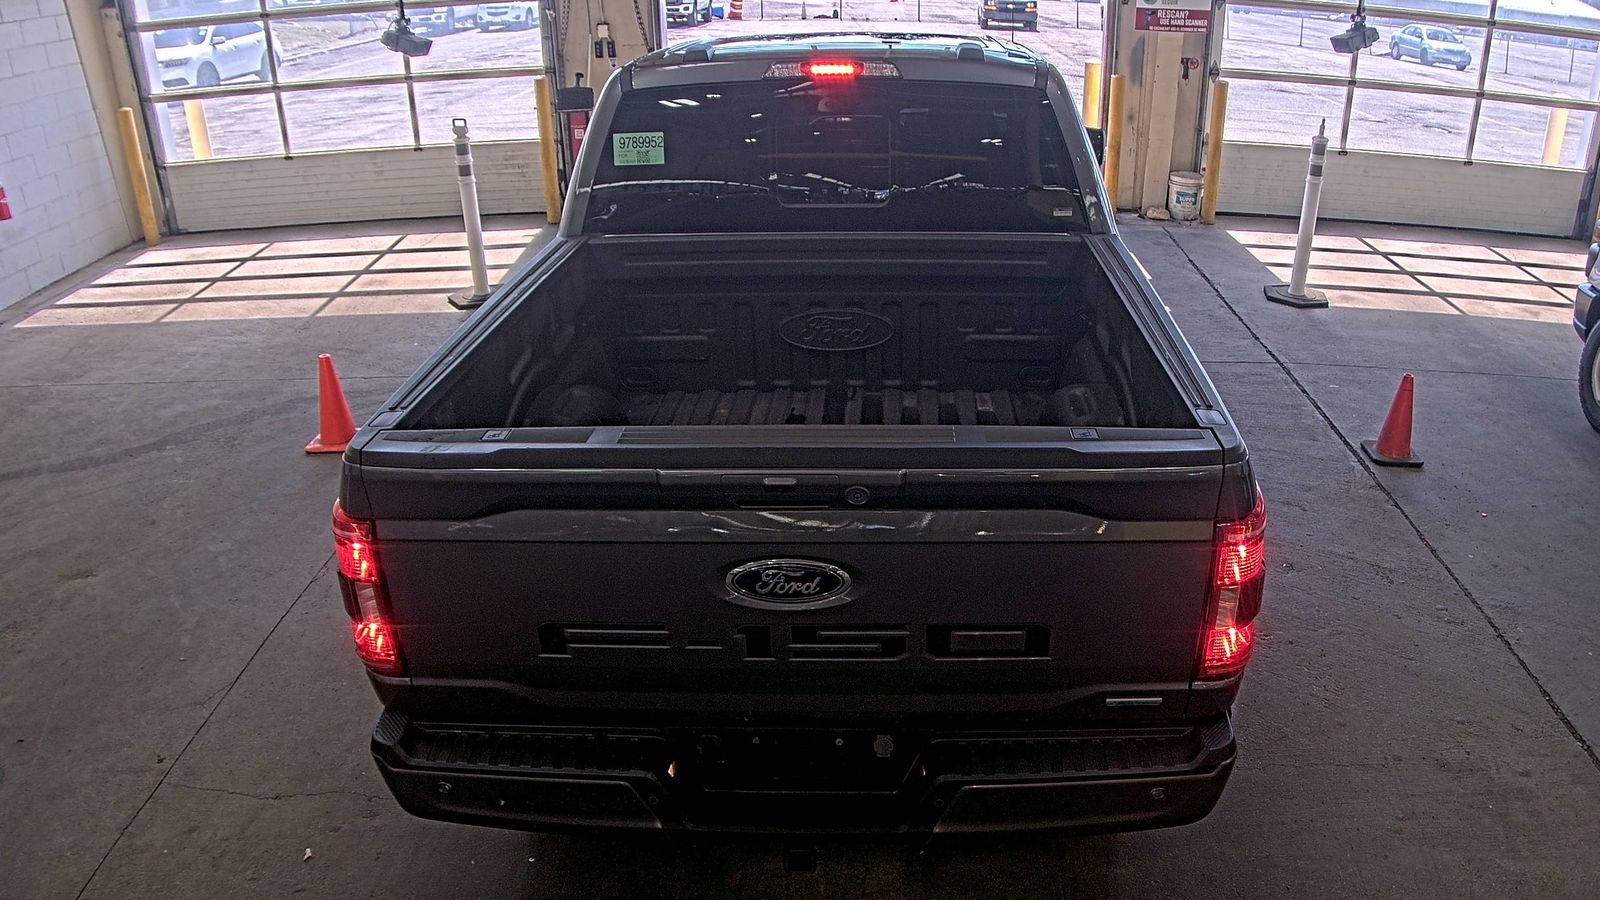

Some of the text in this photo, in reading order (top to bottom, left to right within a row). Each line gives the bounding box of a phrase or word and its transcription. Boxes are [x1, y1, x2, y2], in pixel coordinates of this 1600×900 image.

[1157, 9, 1189, 19] RESCAN?
[618, 135, 664, 149] 9789952
[800, 315, 871, 342] Ford
[755, 569, 821, 593] Ford
[537, 622, 1052, 661] F-150
